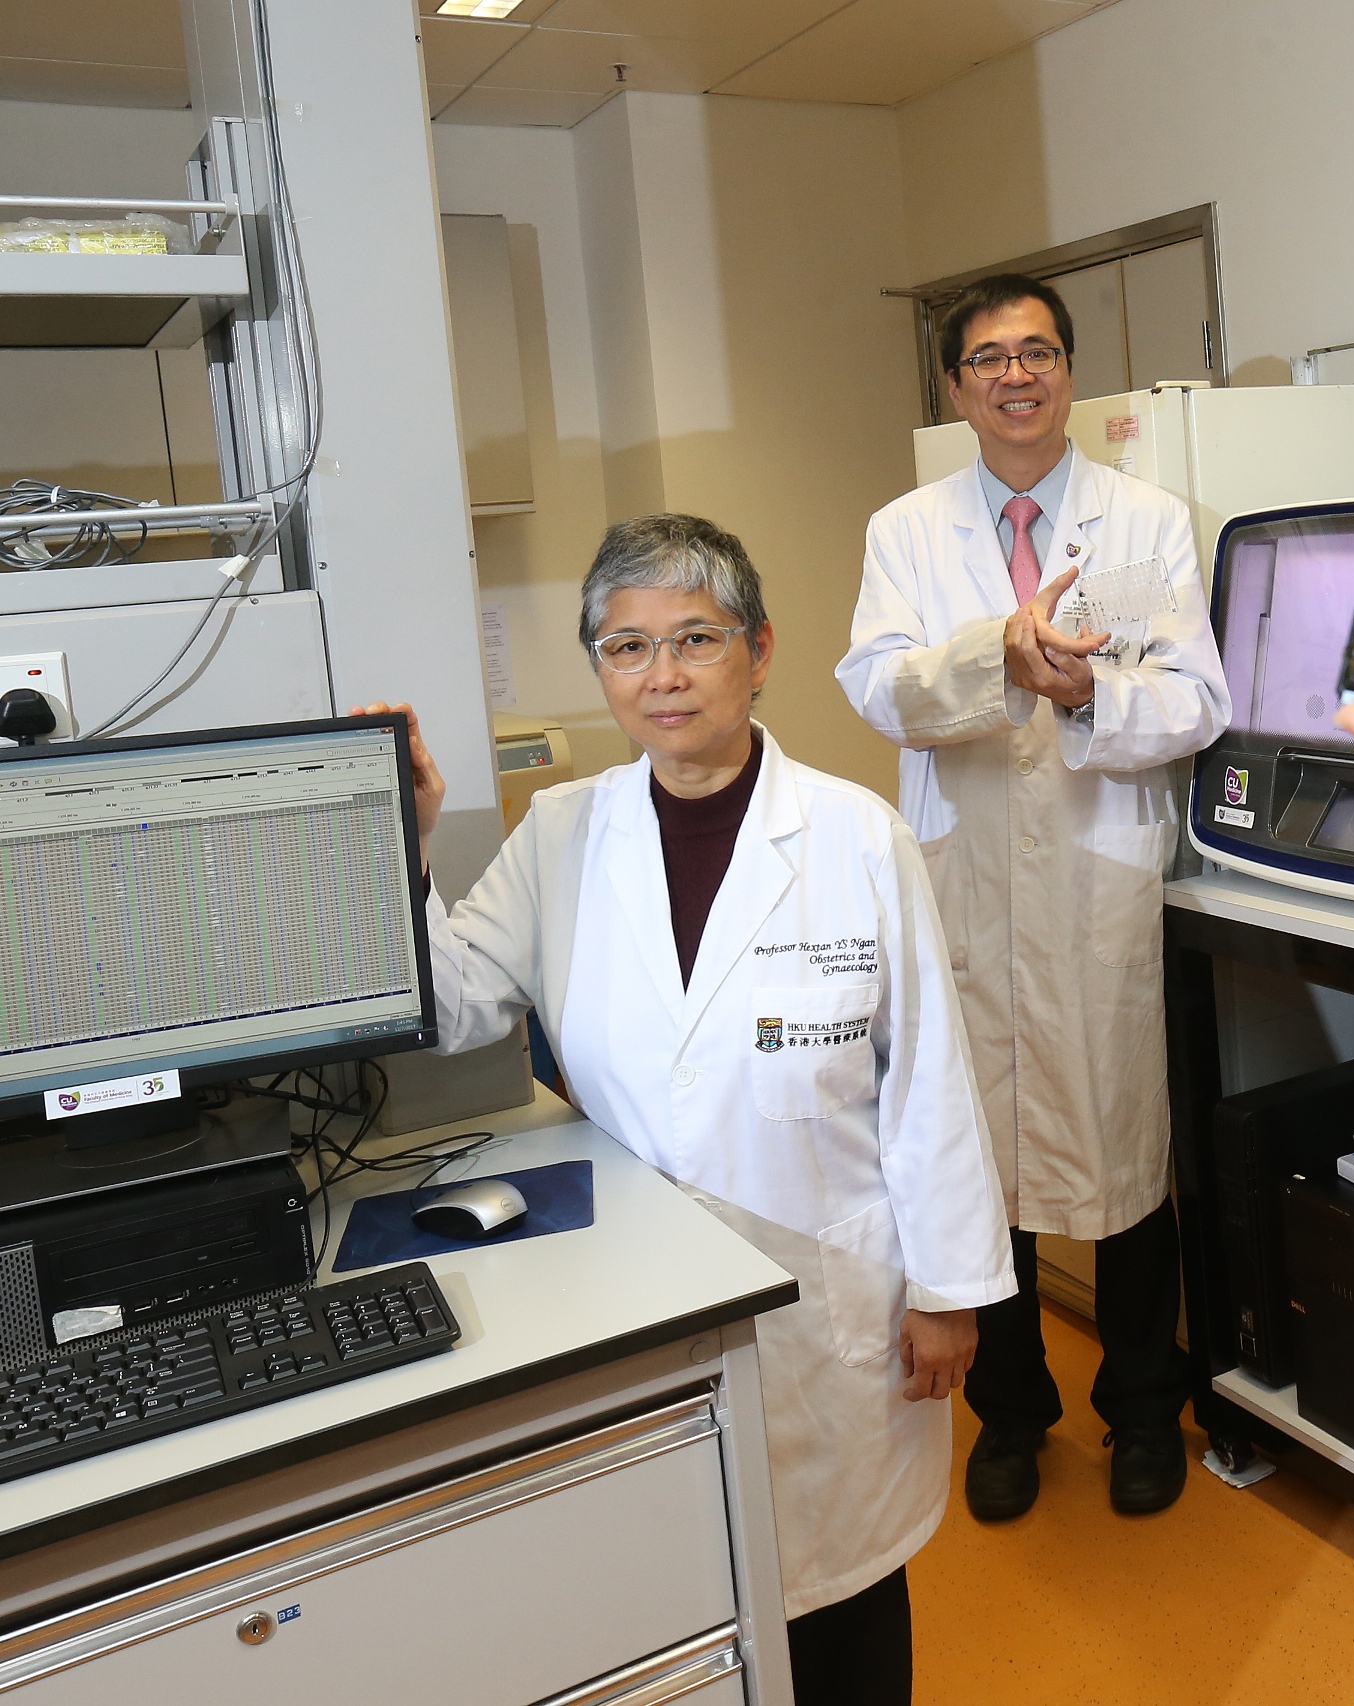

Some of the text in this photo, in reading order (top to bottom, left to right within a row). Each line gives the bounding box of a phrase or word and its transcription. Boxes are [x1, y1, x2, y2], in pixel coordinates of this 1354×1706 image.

[1228, 777, 1238, 788] CU
[754, 938, 876, 957] Professor Hextan YS Ngan
[810, 950, 876, 965] Obstetrics and
[822, 962, 878, 977] Gynaecology
[788, 1017, 870, 1031] HKU HEALTH SYSTEM
[787, 1029, 868, 1047] 香港大學醫療系統
[142, 1077, 164, 1096] 35
[84, 1094, 102, 1102] Faculty
[110, 1090, 132, 1098] Medicine
[1291, 1300, 1306, 1314] DELL
